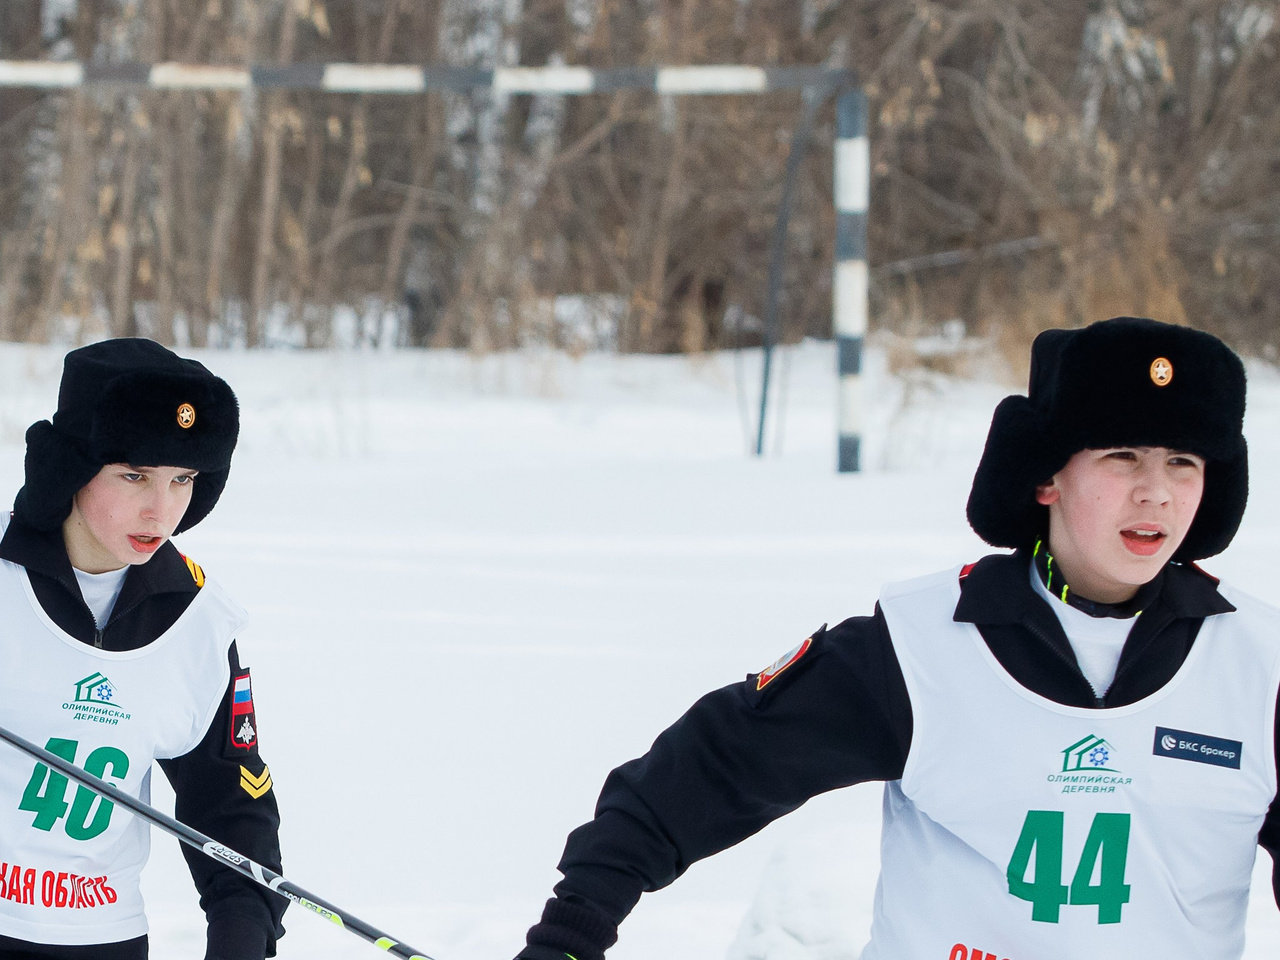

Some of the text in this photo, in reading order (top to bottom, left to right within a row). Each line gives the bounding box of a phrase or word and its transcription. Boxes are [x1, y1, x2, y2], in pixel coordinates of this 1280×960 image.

[62, 702, 131, 720] ОЛИМПИЙСКАЯ
[73, 712, 119, 726] ДЕРЕВНЯ
[1178, 740, 1236, 759] БКС брокер
[1047, 774, 1132, 785] ОЛИМПИЙСКАЯ
[18, 737, 130, 841] 46
[1061, 785, 1116, 794] ДЕРЕВНЯ
[1006, 810, 1131, 924] 44
[41, 870, 118, 908] ОБЛАСТЬ
